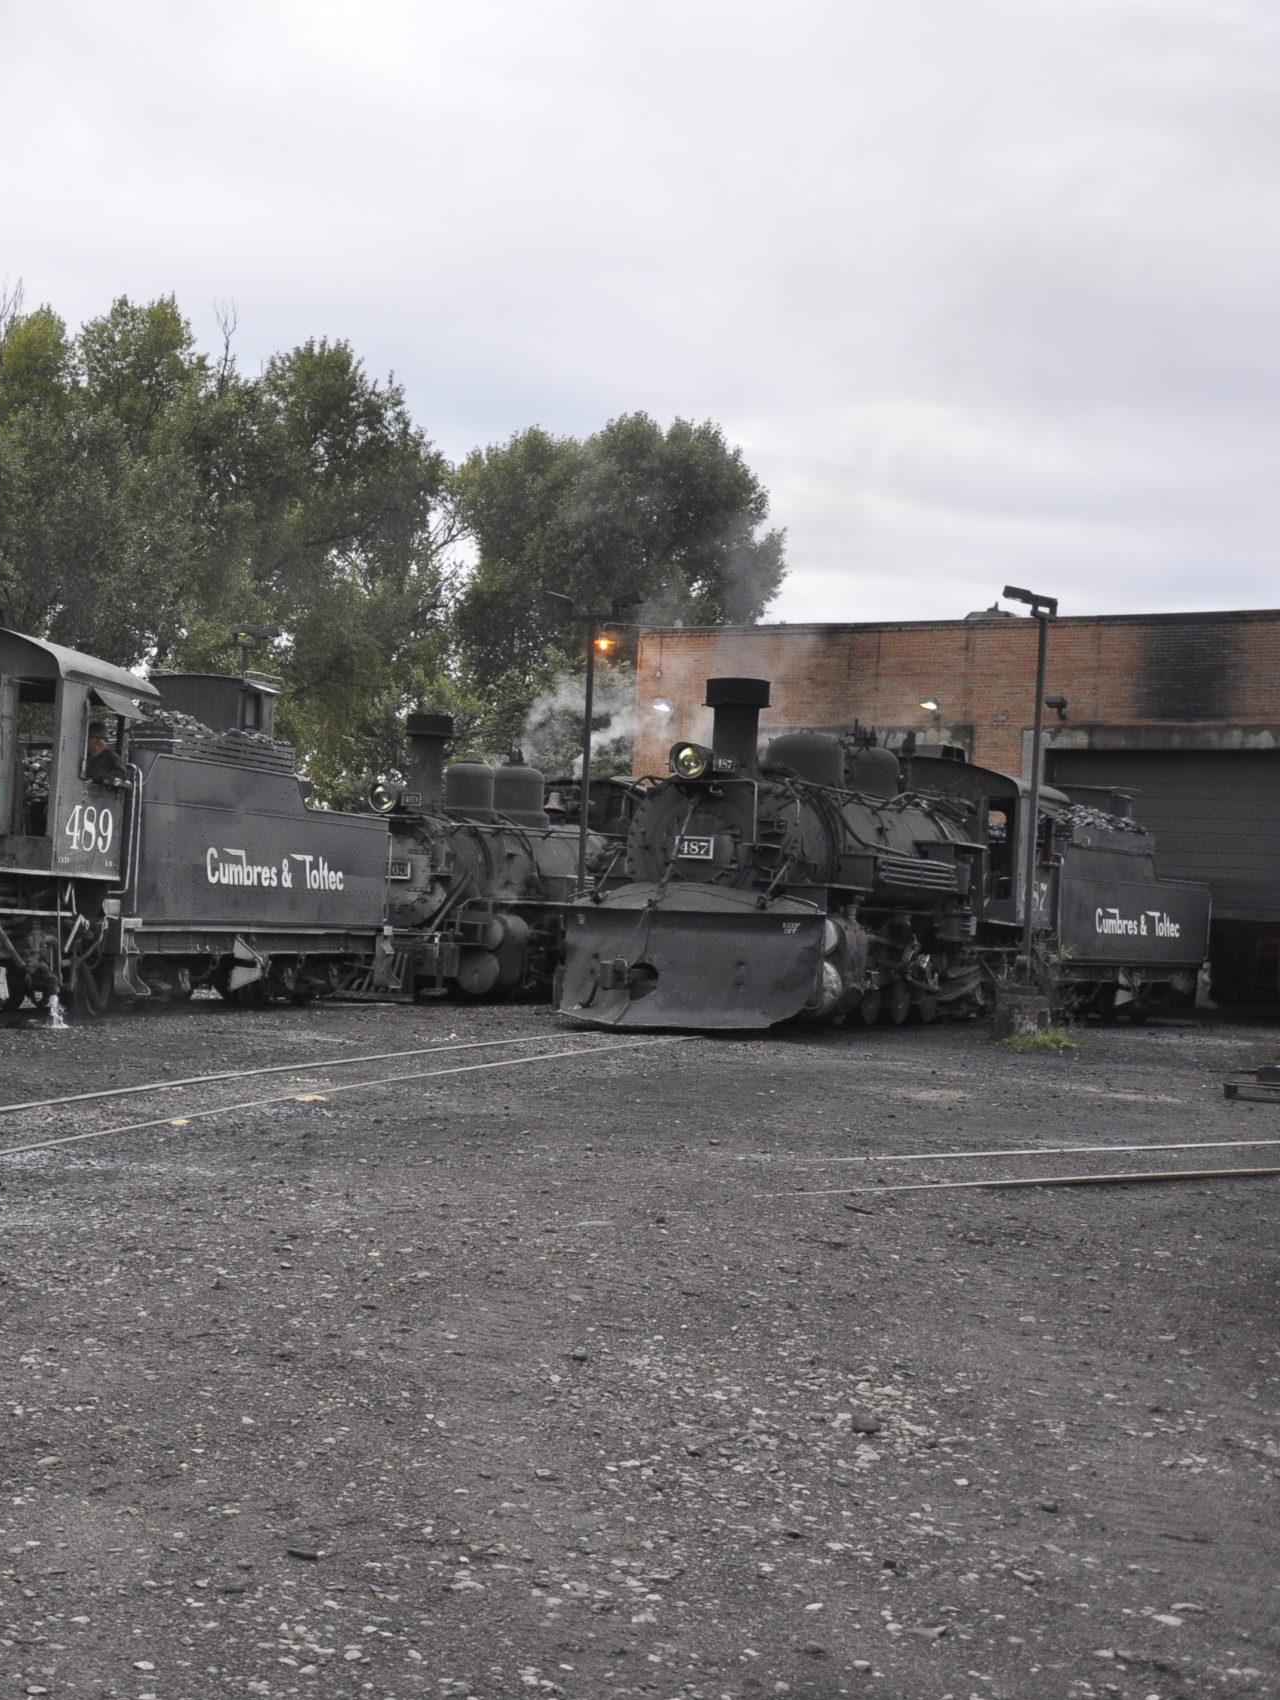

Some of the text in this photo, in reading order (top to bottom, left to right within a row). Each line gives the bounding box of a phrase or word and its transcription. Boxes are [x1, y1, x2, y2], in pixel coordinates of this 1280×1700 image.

[65, 805, 113, 853] 489
[680, 841, 709, 855] 487
[206, 847, 344, 891] Cumbres & Toltec
[1022, 880, 1047, 912] 87
[1095, 908, 1180, 938] Cumbres & Toltec
